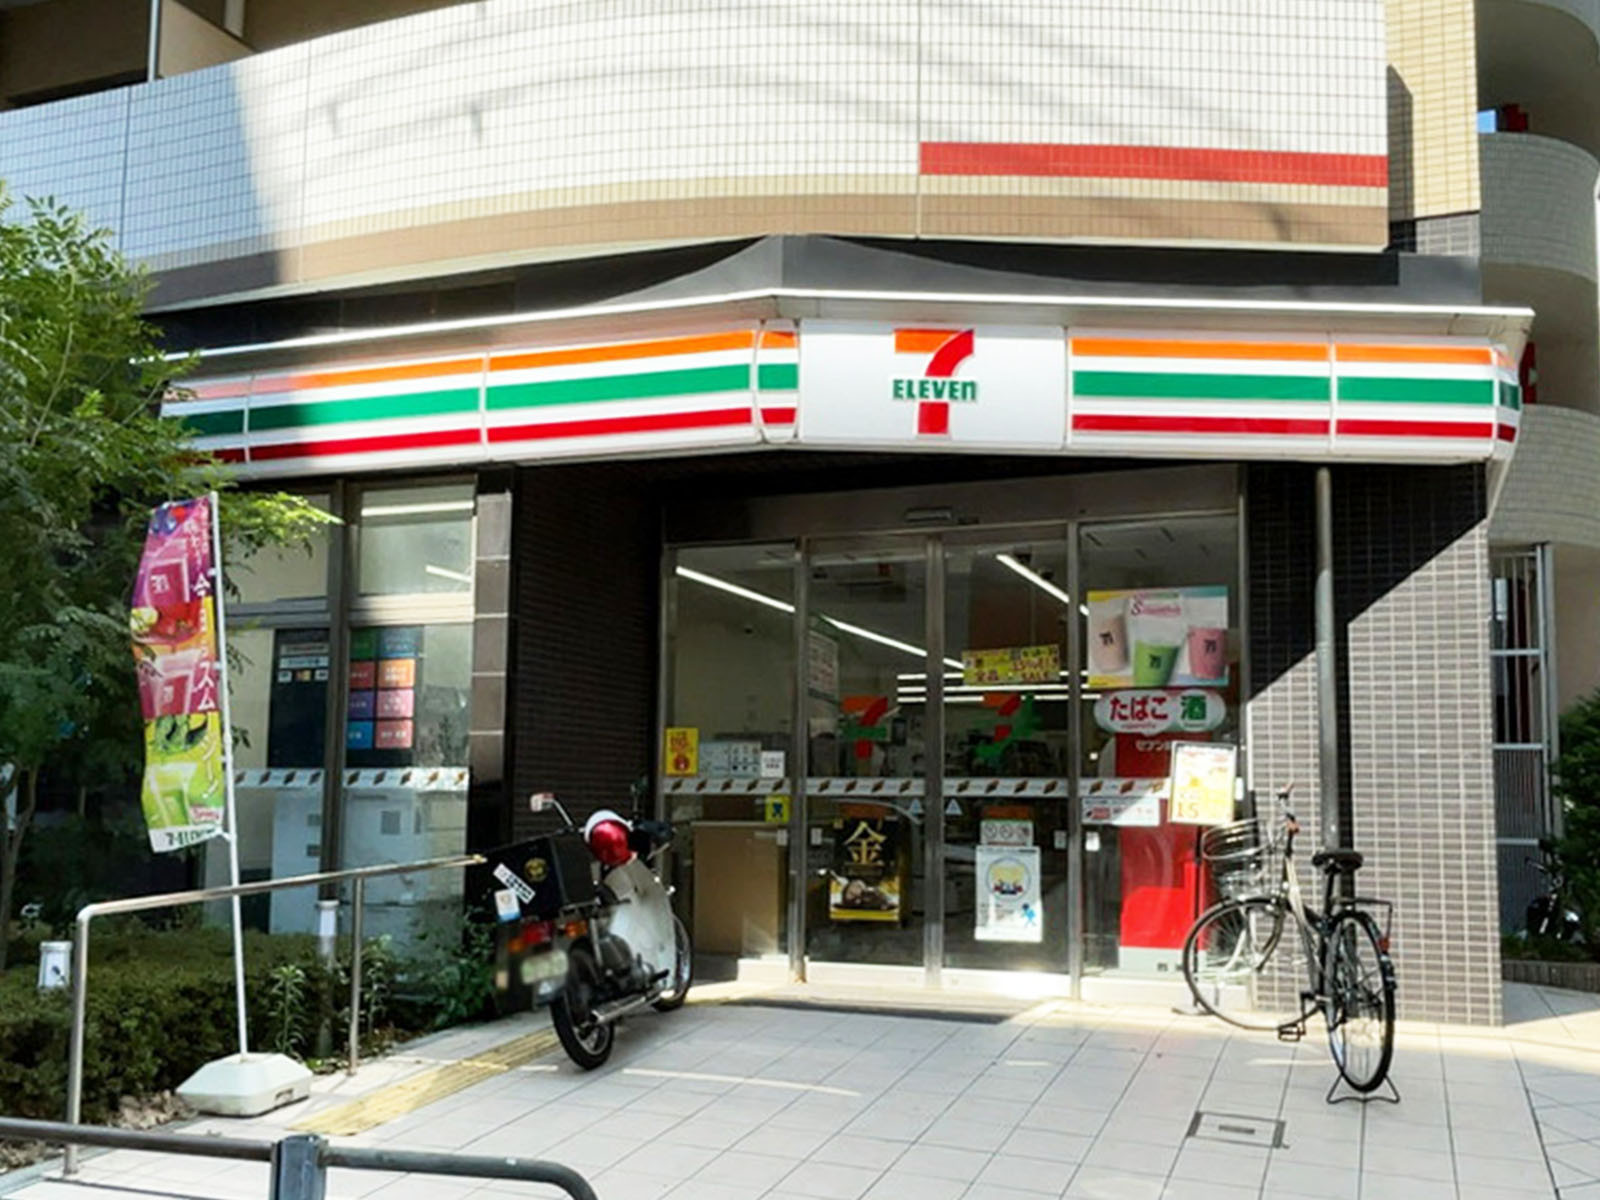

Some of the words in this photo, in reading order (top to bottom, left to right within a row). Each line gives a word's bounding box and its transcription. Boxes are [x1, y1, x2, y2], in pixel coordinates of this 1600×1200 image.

[894, 328, 974, 434] 7
[1110, 696, 1168, 720] たばこ
[1180, 695, 1206, 720] 酒
[844, 821, 886, 865] 金
